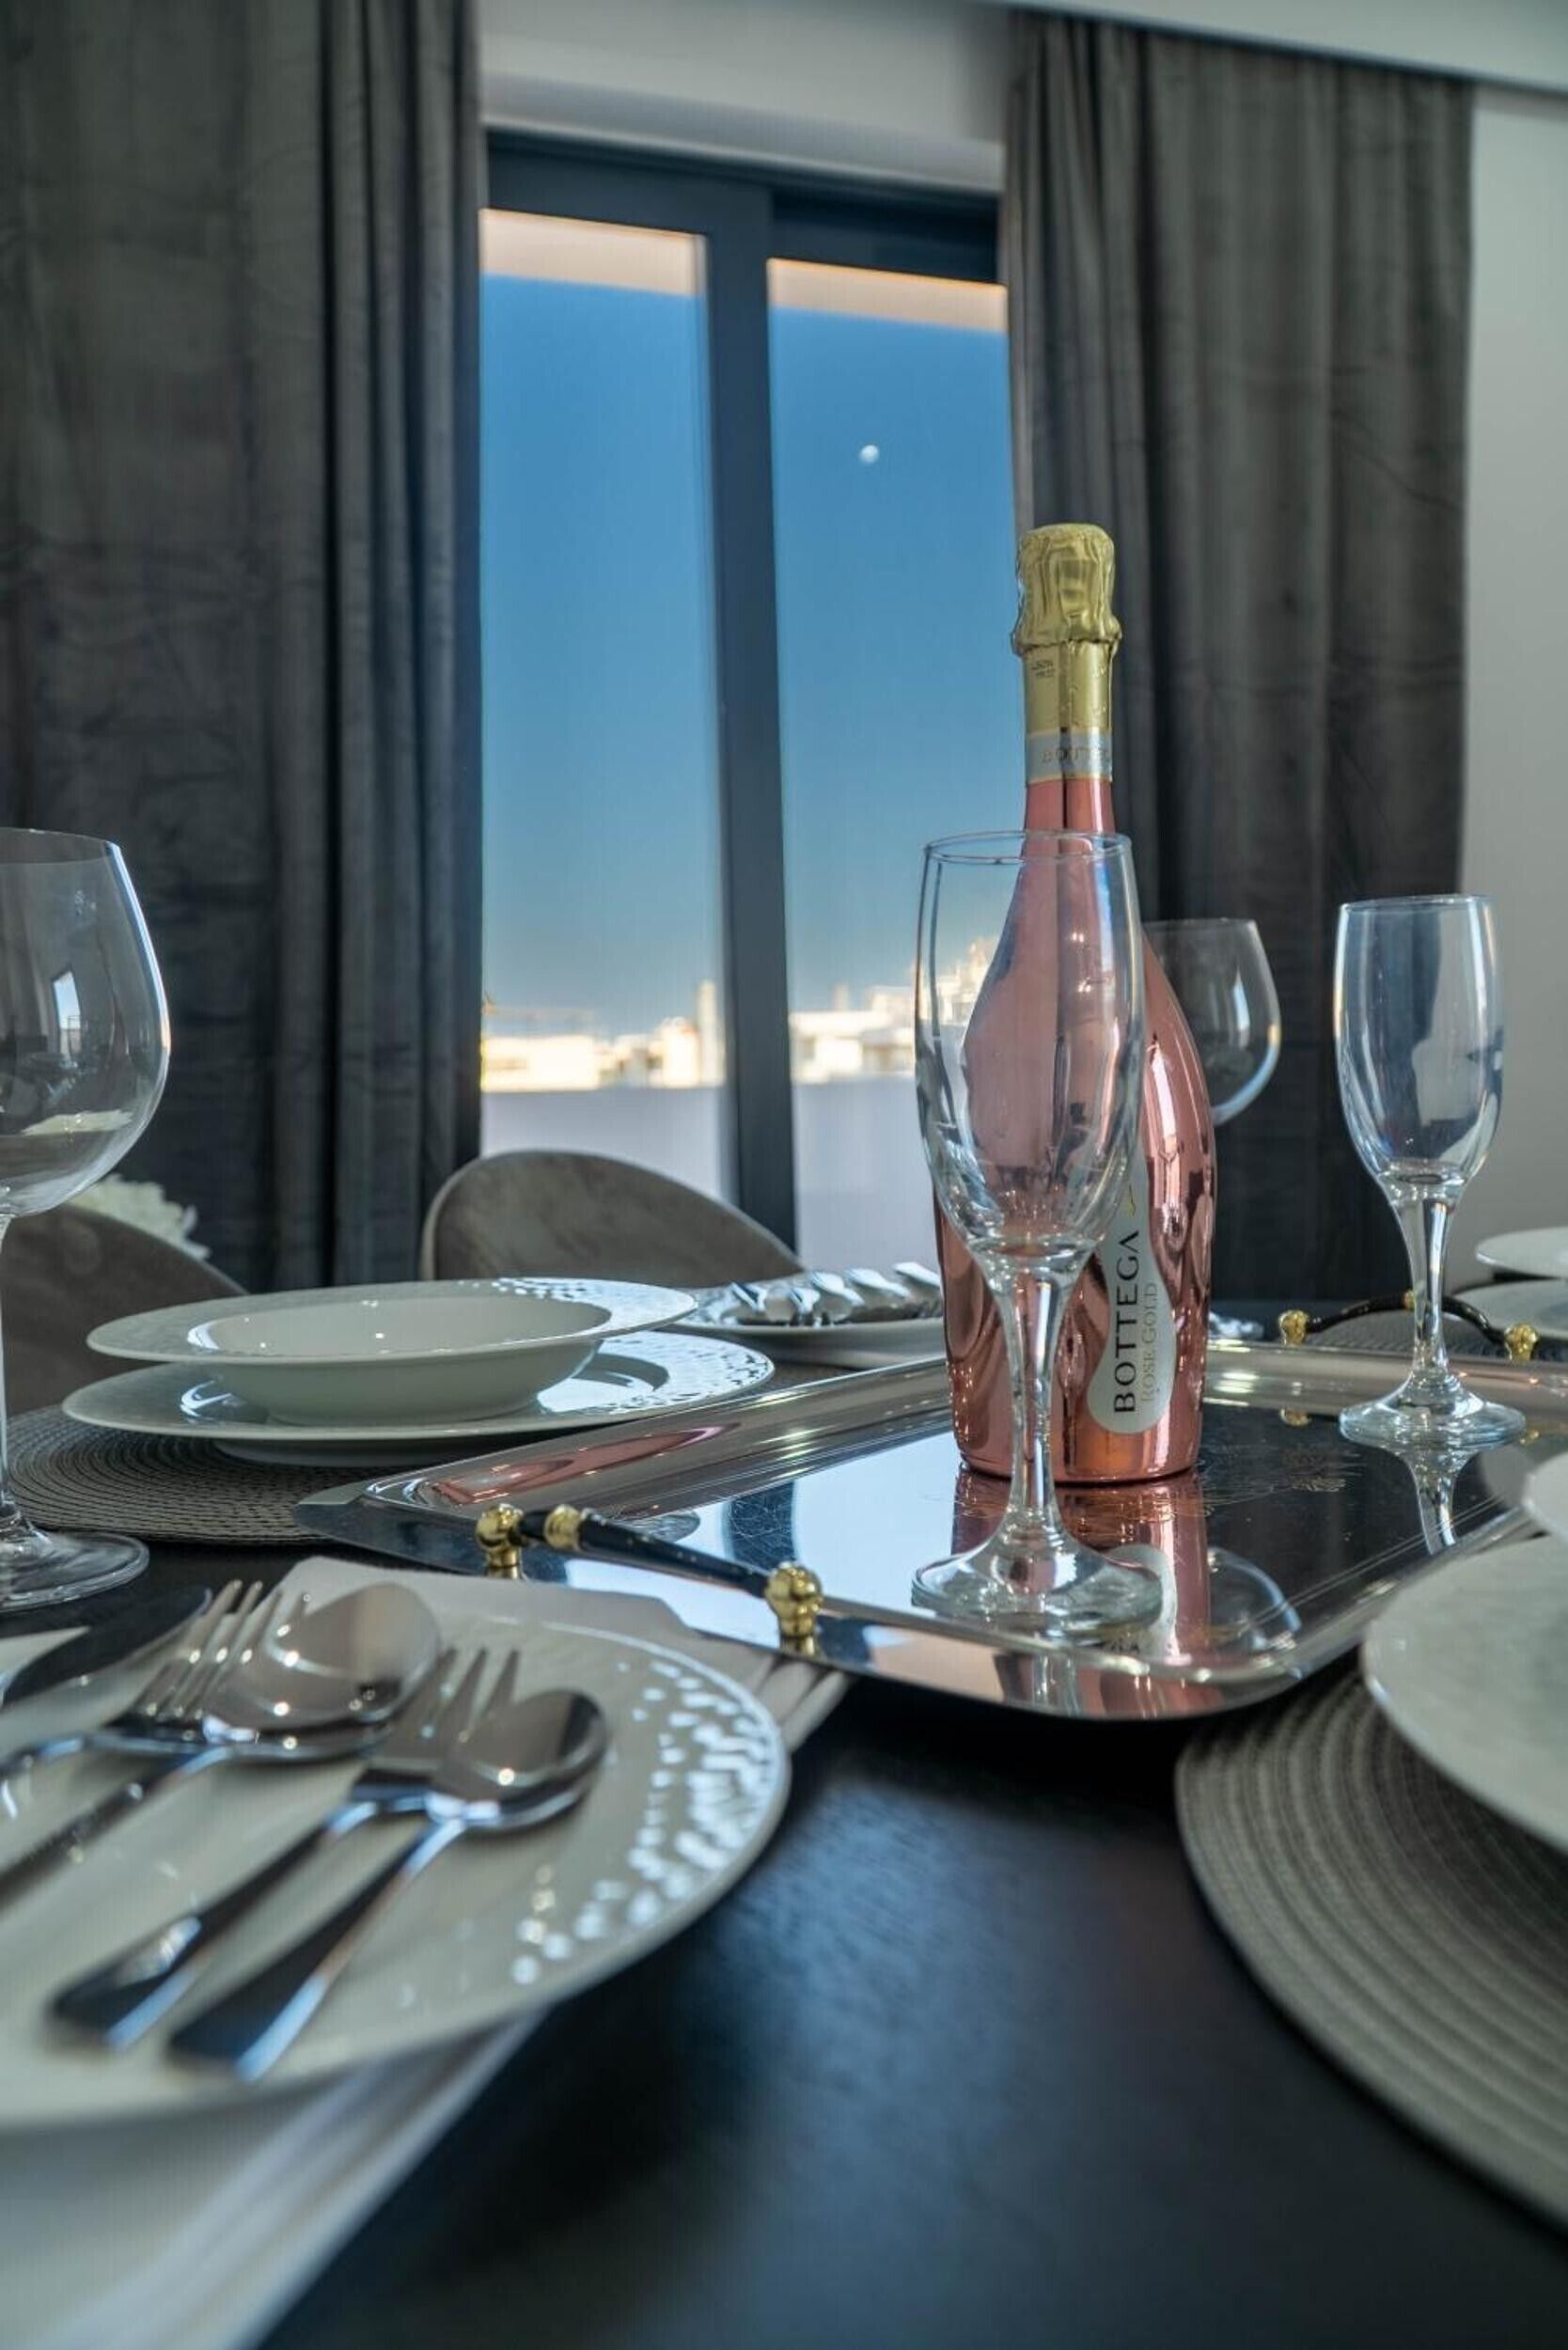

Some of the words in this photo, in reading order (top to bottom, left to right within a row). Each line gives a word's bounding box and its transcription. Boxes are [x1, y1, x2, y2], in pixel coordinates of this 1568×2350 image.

[1113, 1230, 1139, 1412] BOTTEGA
[1142, 1282, 1158, 1344] GOLD
[1141, 1351, 1157, 1402] ROSE
